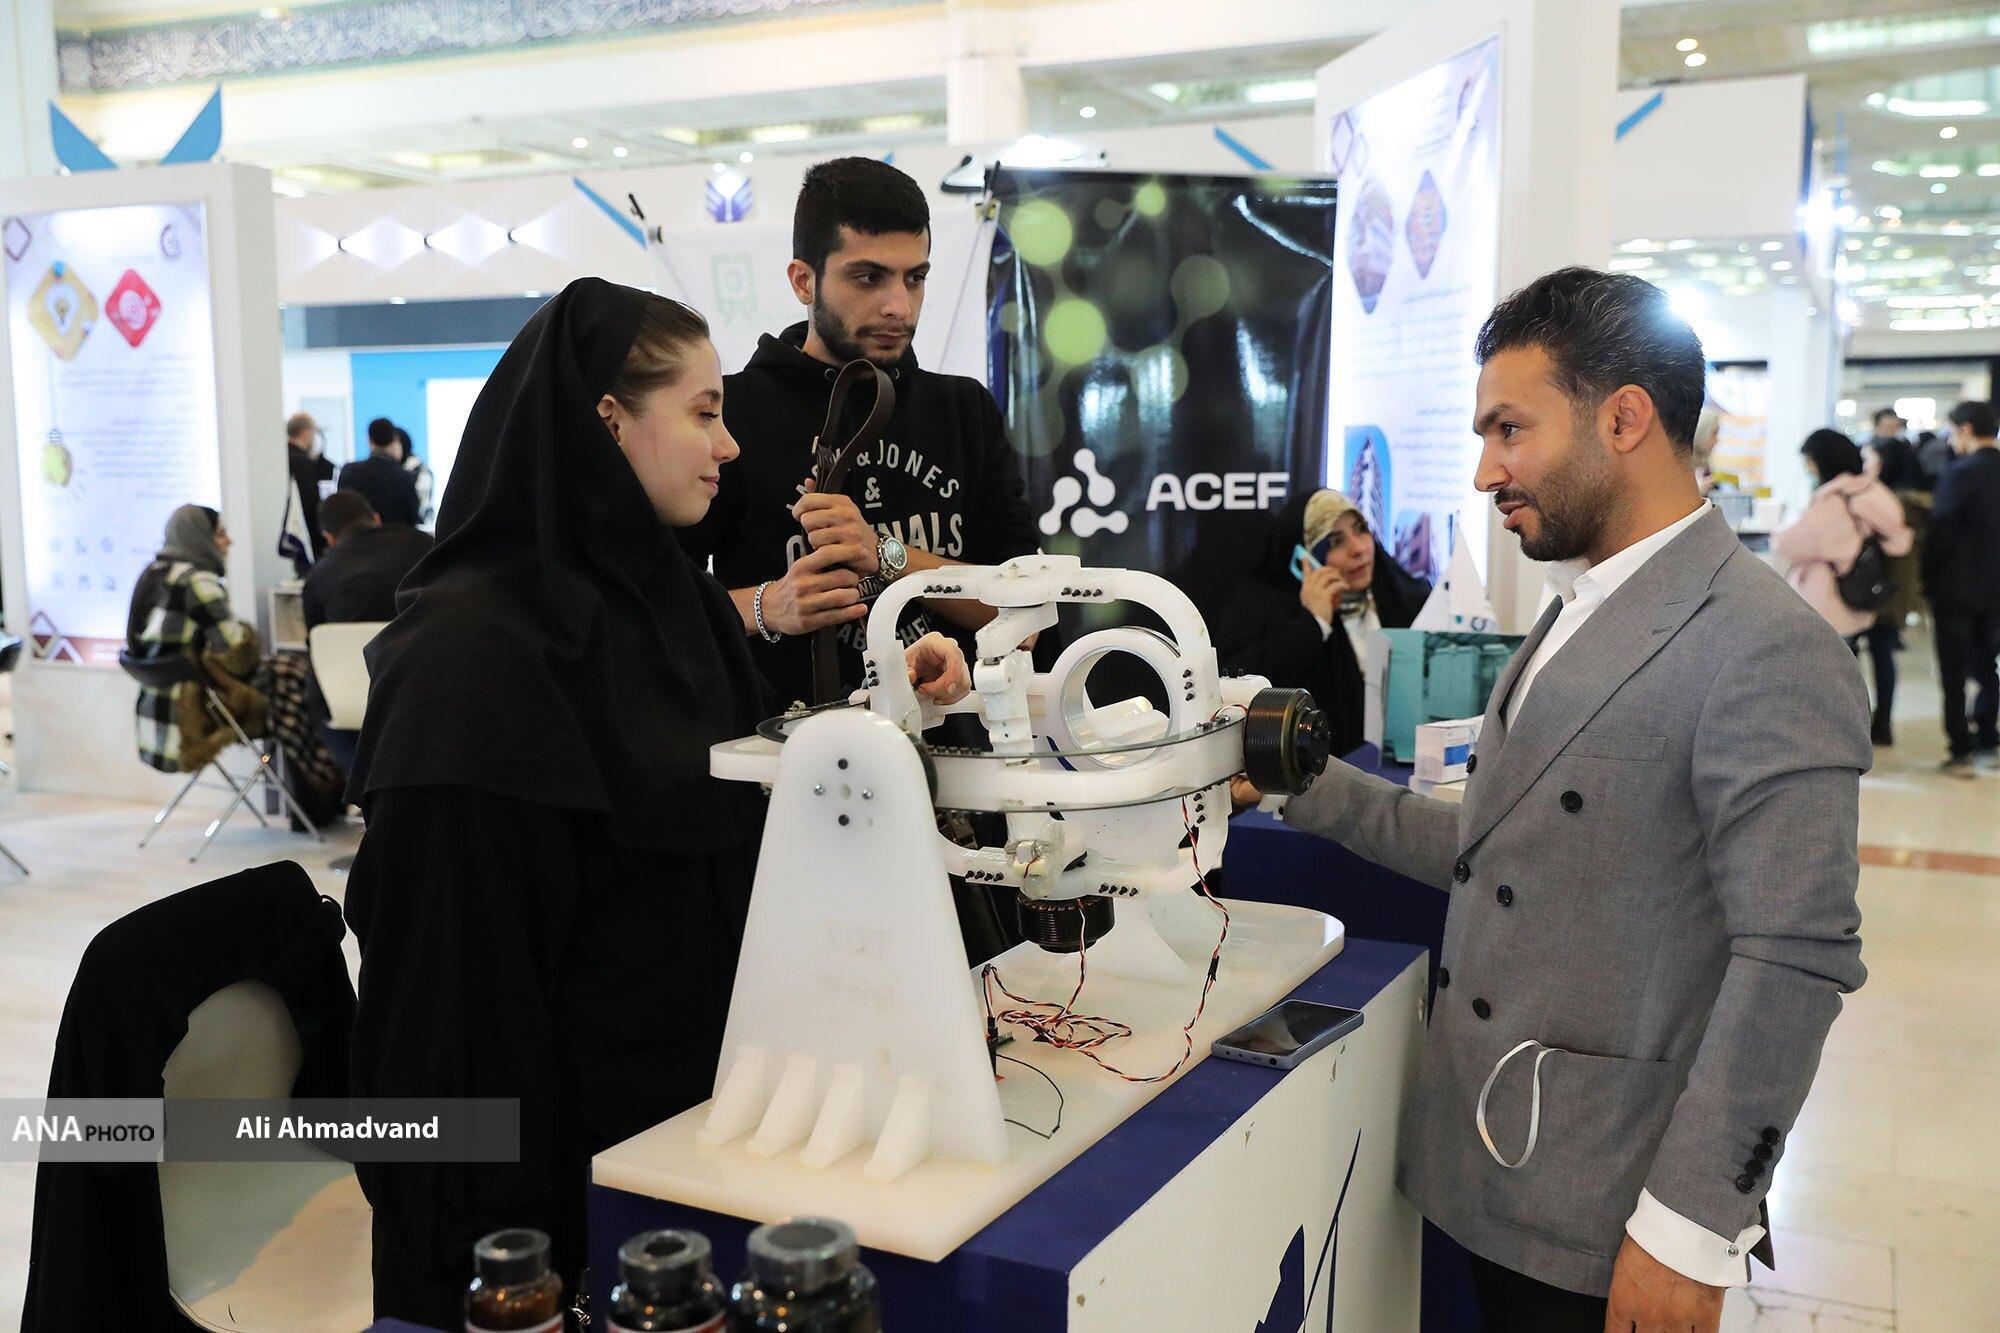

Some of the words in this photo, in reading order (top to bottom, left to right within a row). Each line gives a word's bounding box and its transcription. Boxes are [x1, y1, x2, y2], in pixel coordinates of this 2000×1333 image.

[856, 451, 871, 467] &
[877, 439, 960, 498] JONES
[865, 476, 882, 502] &
[1145, 472, 1290, 511] ACEF
